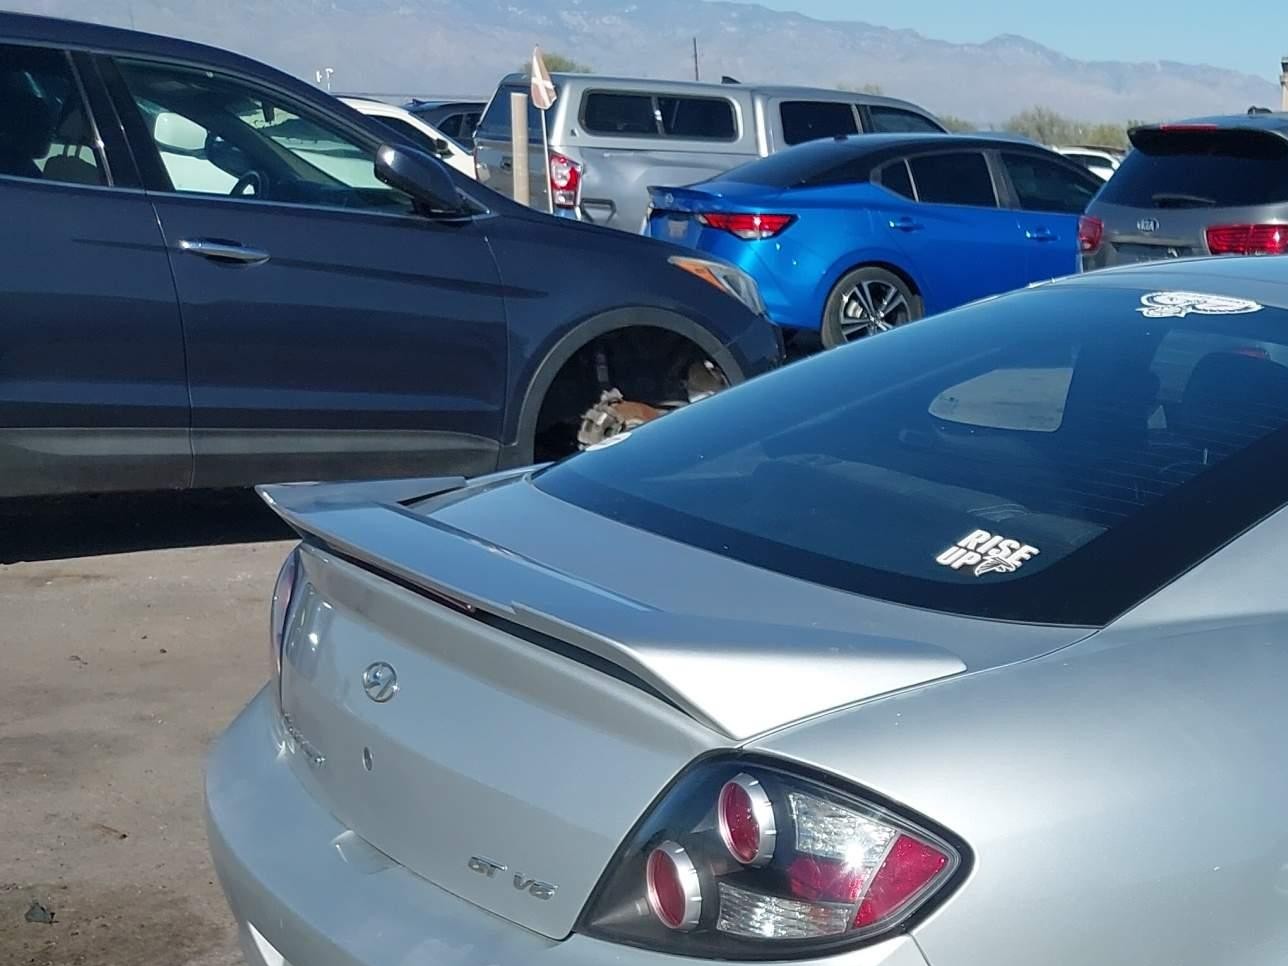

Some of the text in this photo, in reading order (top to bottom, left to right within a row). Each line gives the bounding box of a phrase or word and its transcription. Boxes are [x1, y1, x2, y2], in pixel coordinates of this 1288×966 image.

[935, 546, 982, 569] UP
[956, 529, 1040, 568] RISE
[468, 856, 559, 900] GT V6
